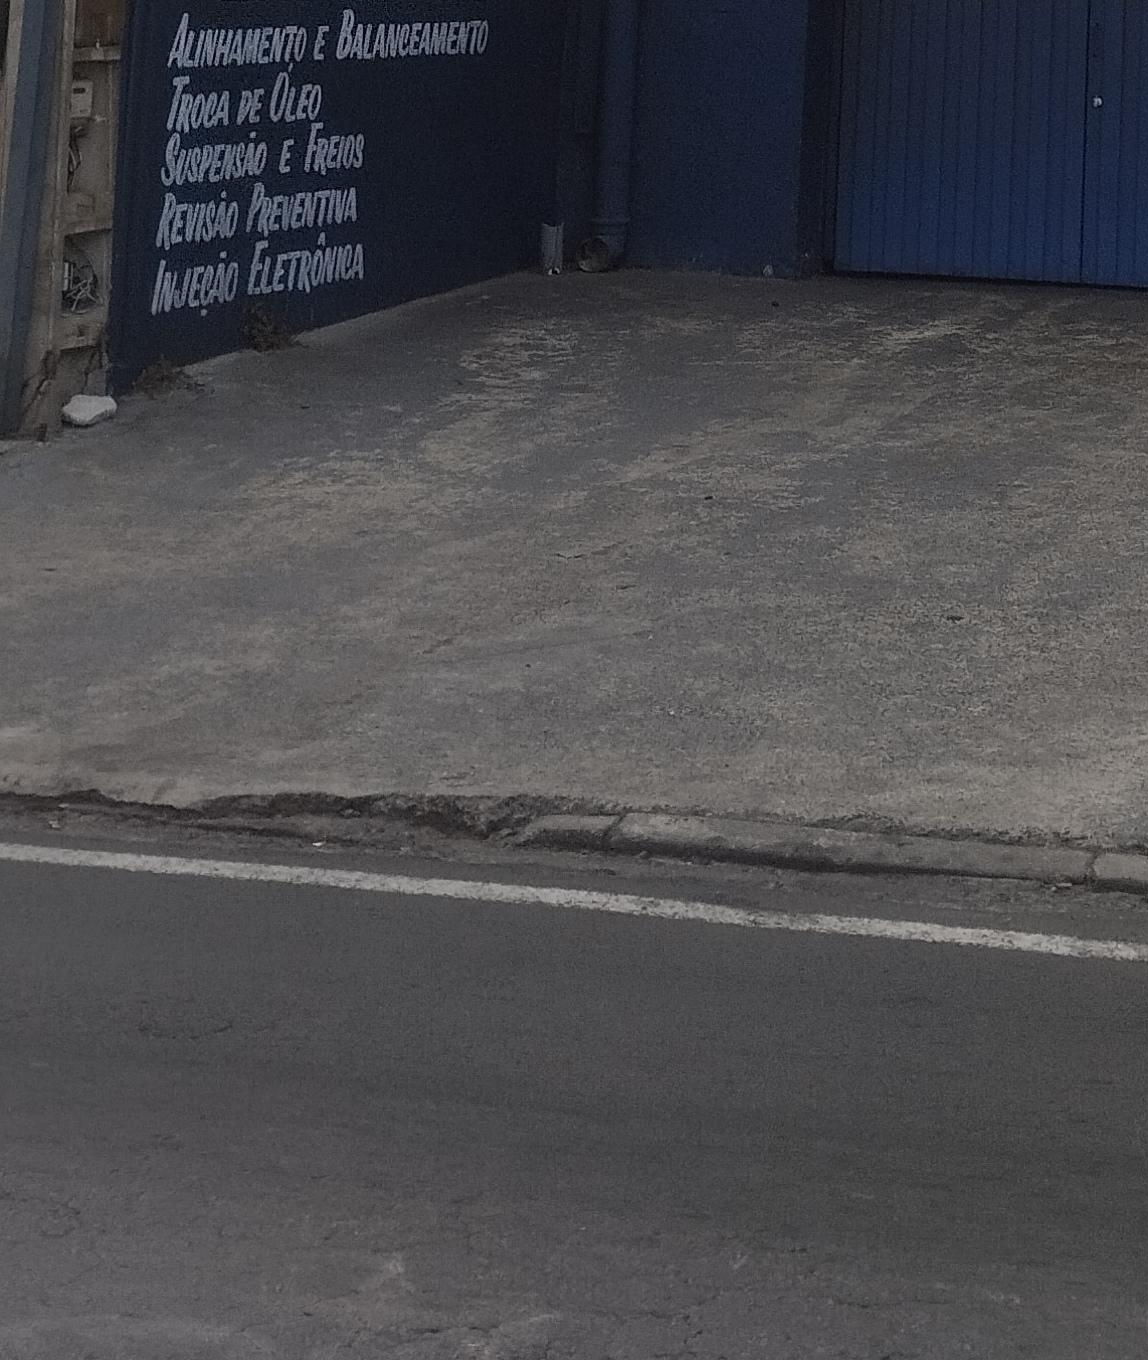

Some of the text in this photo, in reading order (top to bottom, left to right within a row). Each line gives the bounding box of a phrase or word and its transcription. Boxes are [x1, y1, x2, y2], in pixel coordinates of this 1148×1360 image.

[167, 9, 489, 69] ALINHAMENTO E BALANCEAMENTO
[167, 63, 323, 132] TROCA DE ÓLEO
[161, 122, 365, 187] SUSPENSÃO E FREIOS
[155, 182, 358, 251] REVISÃO PREVENTIVA
[151, 232, 365, 317] INJEÇÃO ELETRÔNICA
